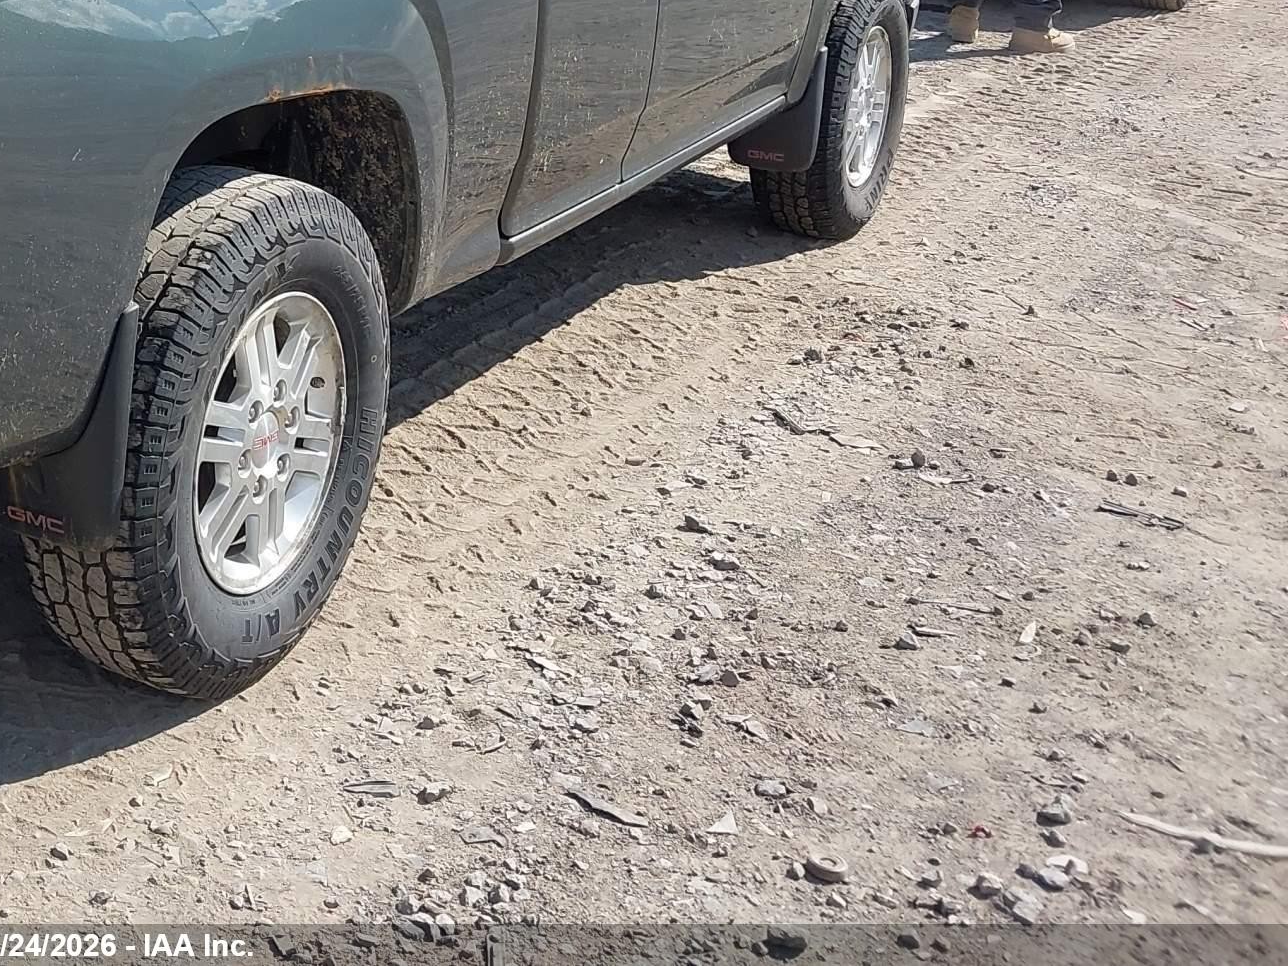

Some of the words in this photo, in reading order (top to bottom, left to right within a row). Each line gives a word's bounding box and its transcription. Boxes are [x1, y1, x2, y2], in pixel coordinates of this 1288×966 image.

[747, 149, 785, 162] GMC
[7, 505, 65, 534] GMC
[292, 407, 378, 622] HICOUNTRY
